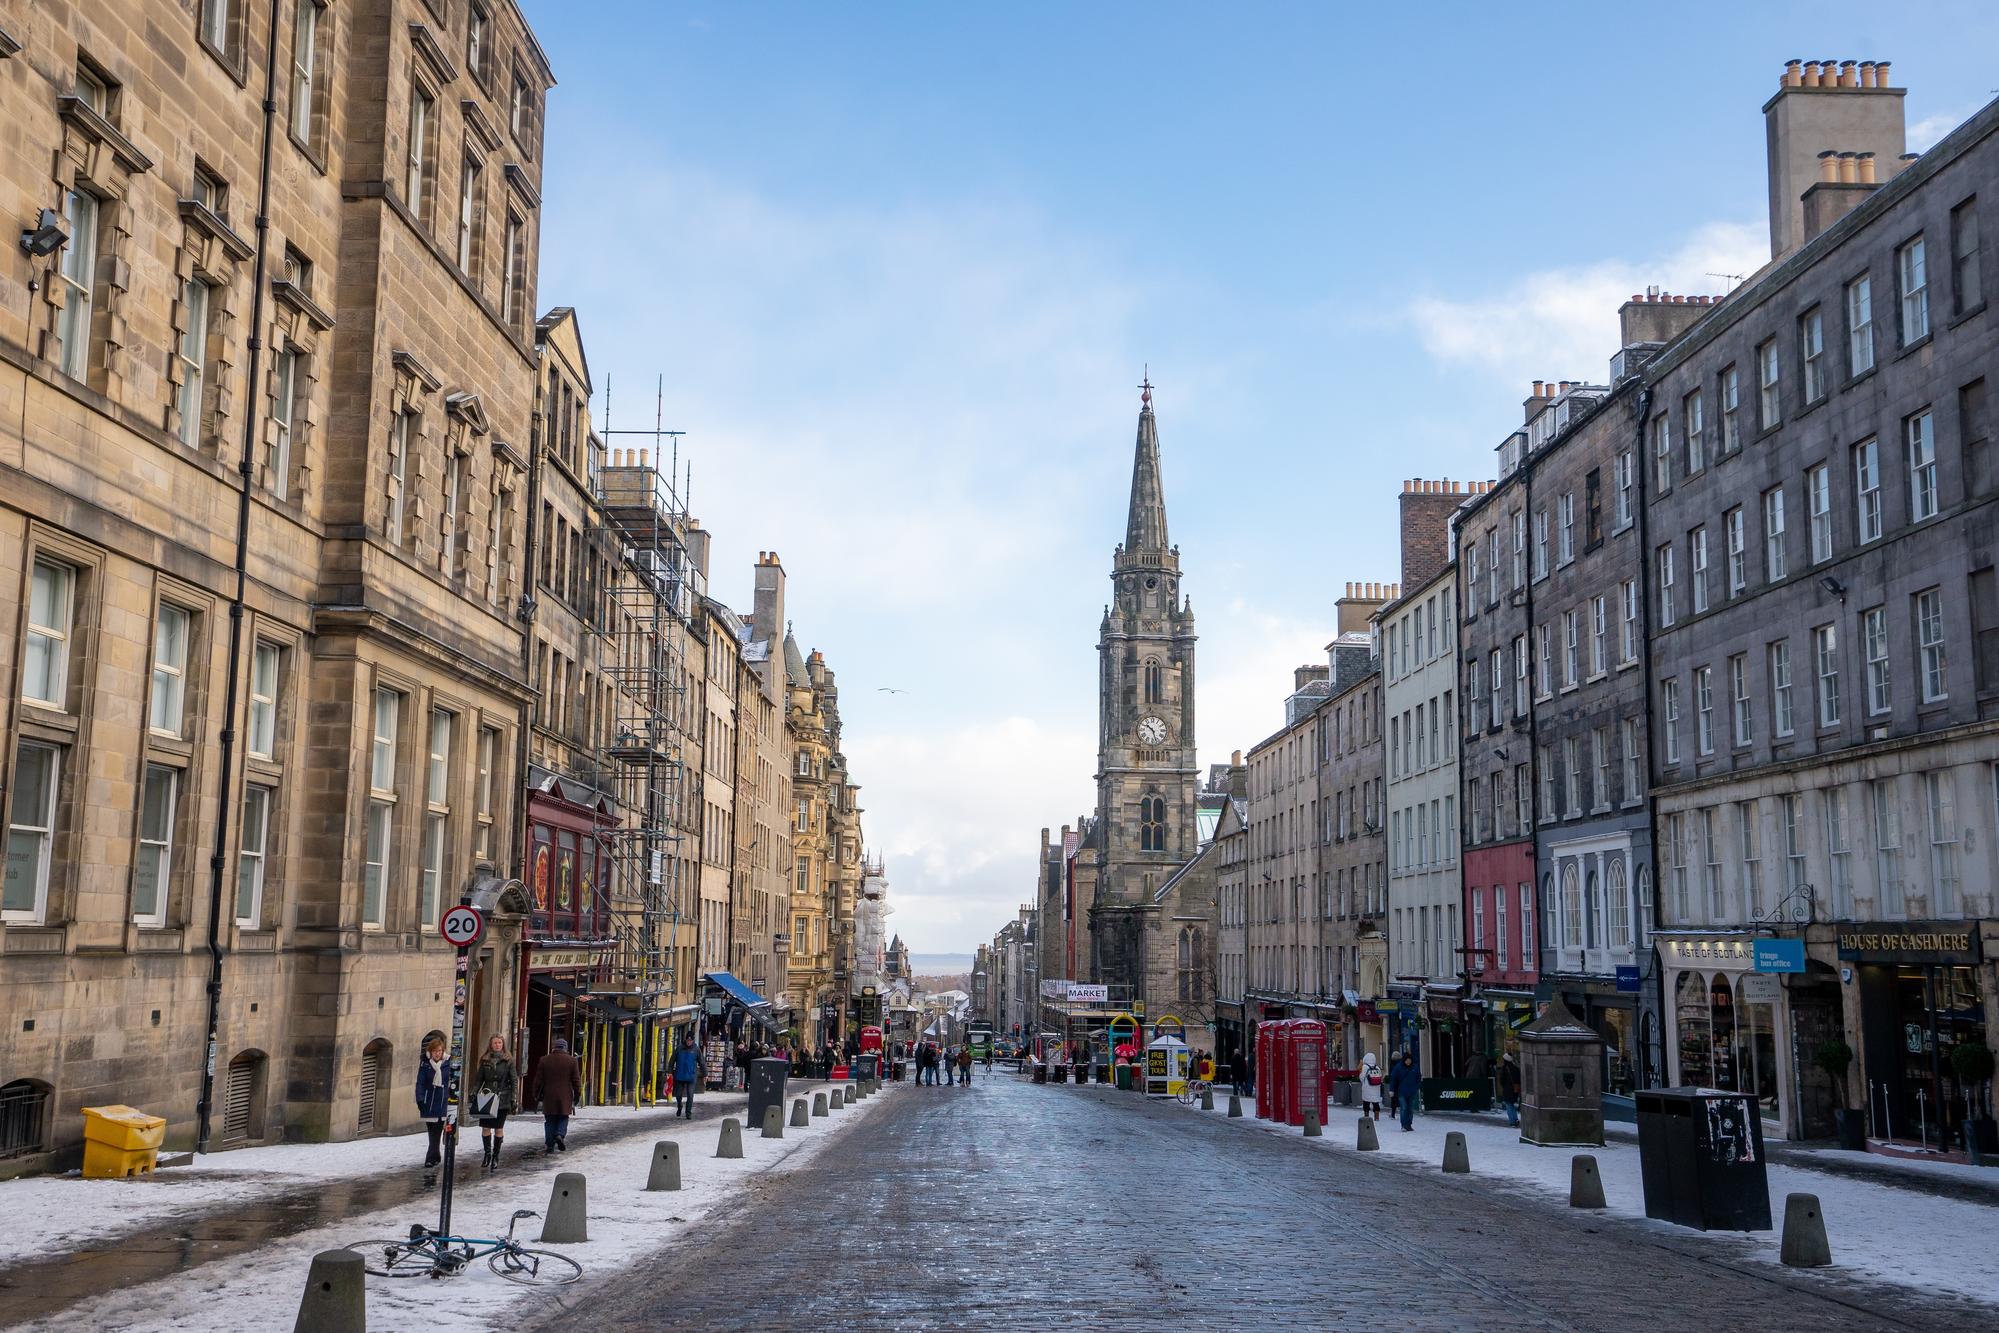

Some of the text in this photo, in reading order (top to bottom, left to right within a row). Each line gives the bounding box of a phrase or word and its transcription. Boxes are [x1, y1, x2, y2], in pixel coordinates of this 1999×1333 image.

[447, 917, 476, 934] 20
[1840, 934, 1969, 951] HOUSE OF CASHMERE
[1678, 948, 1700, 958] TASTE
[1701, 949, 1711, 958] OF
[1068, 989, 1106, 997] MARKET
[1148, 1059, 1166, 1067] GHOST
[1150, 1067, 1166, 1075] TOUR
[1439, 1090, 1474, 1099] SUBWAY
